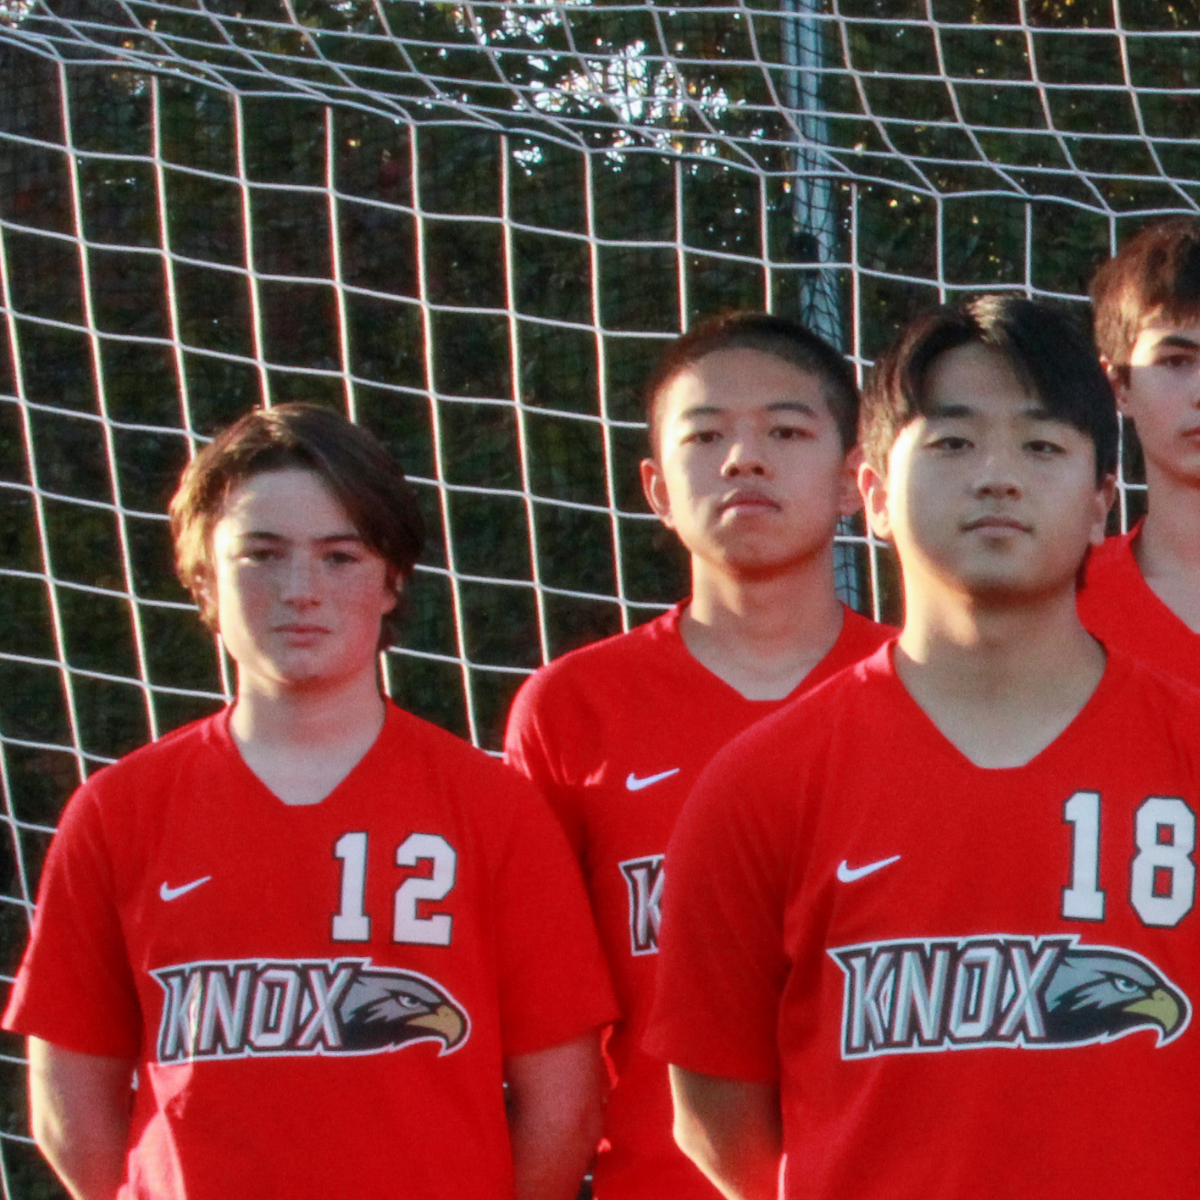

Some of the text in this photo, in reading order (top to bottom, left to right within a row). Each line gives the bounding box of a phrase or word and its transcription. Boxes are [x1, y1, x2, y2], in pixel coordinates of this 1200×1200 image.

[329, 830, 457, 946] 12
[1060, 790, 1198, 928] 18
[154, 958, 366, 1062] KNOX
[828, 936, 1072, 1058] KNOX
